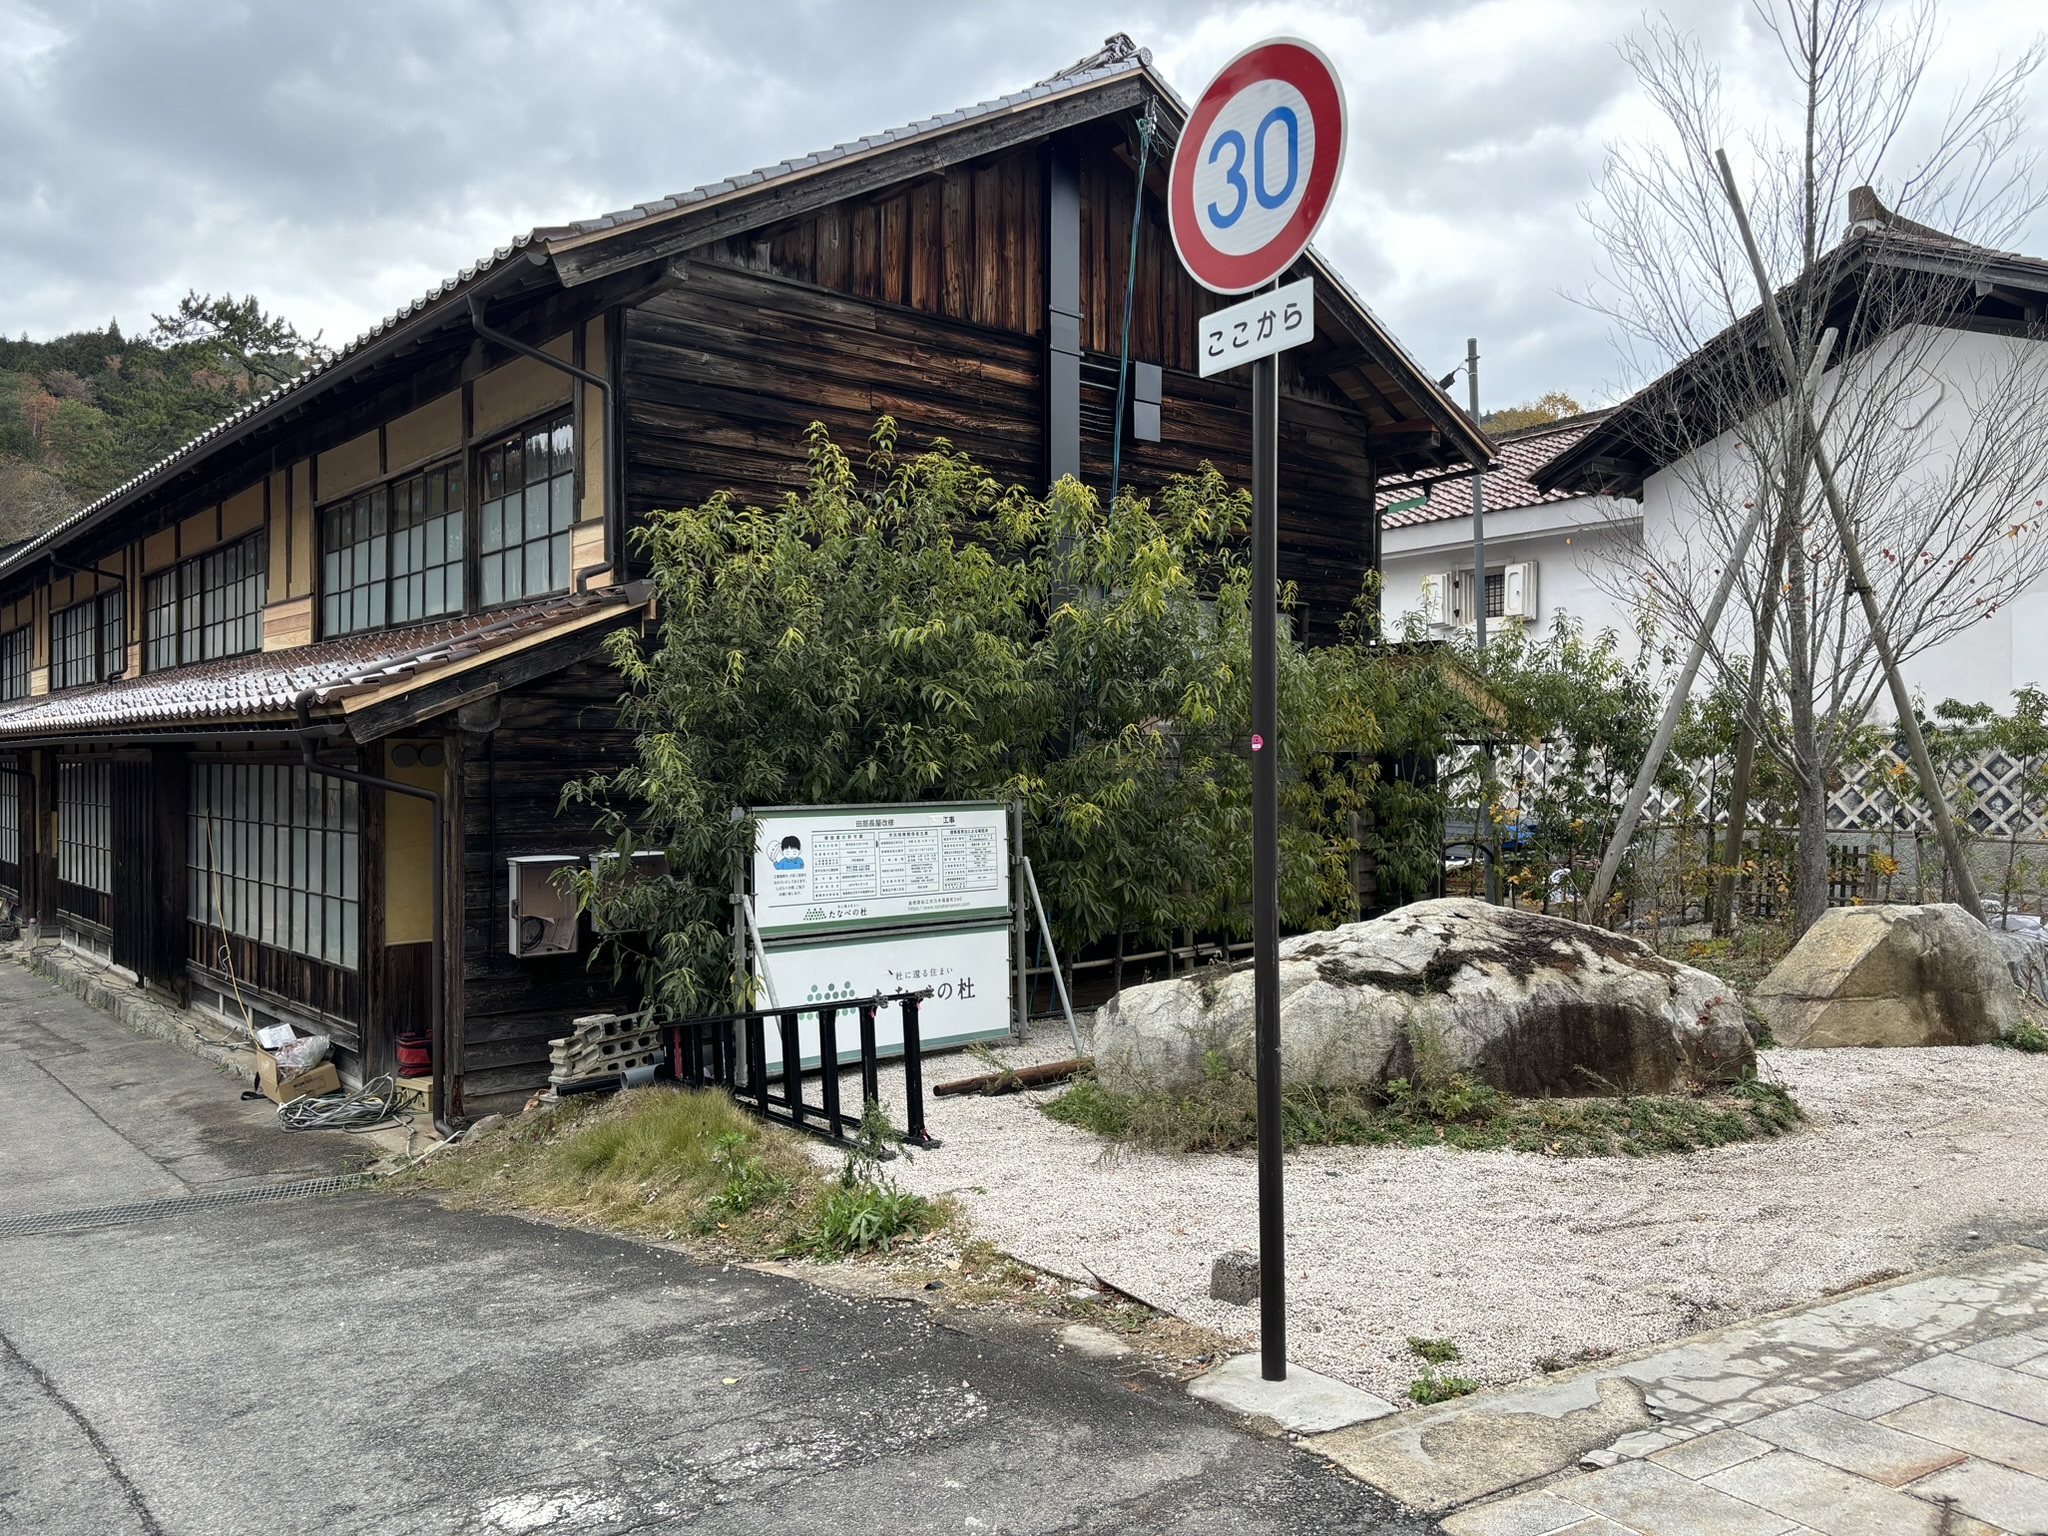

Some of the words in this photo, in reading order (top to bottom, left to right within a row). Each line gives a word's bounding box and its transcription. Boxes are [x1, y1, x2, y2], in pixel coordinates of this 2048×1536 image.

[1207, 106, 1299, 229] 30
[1208, 302, 1304, 358] ここから
[943, 816, 955, 824] 工事
[828, 907, 868, 919] たなべの杜
[895, 967, 953, 981] 杜に還る住まい
